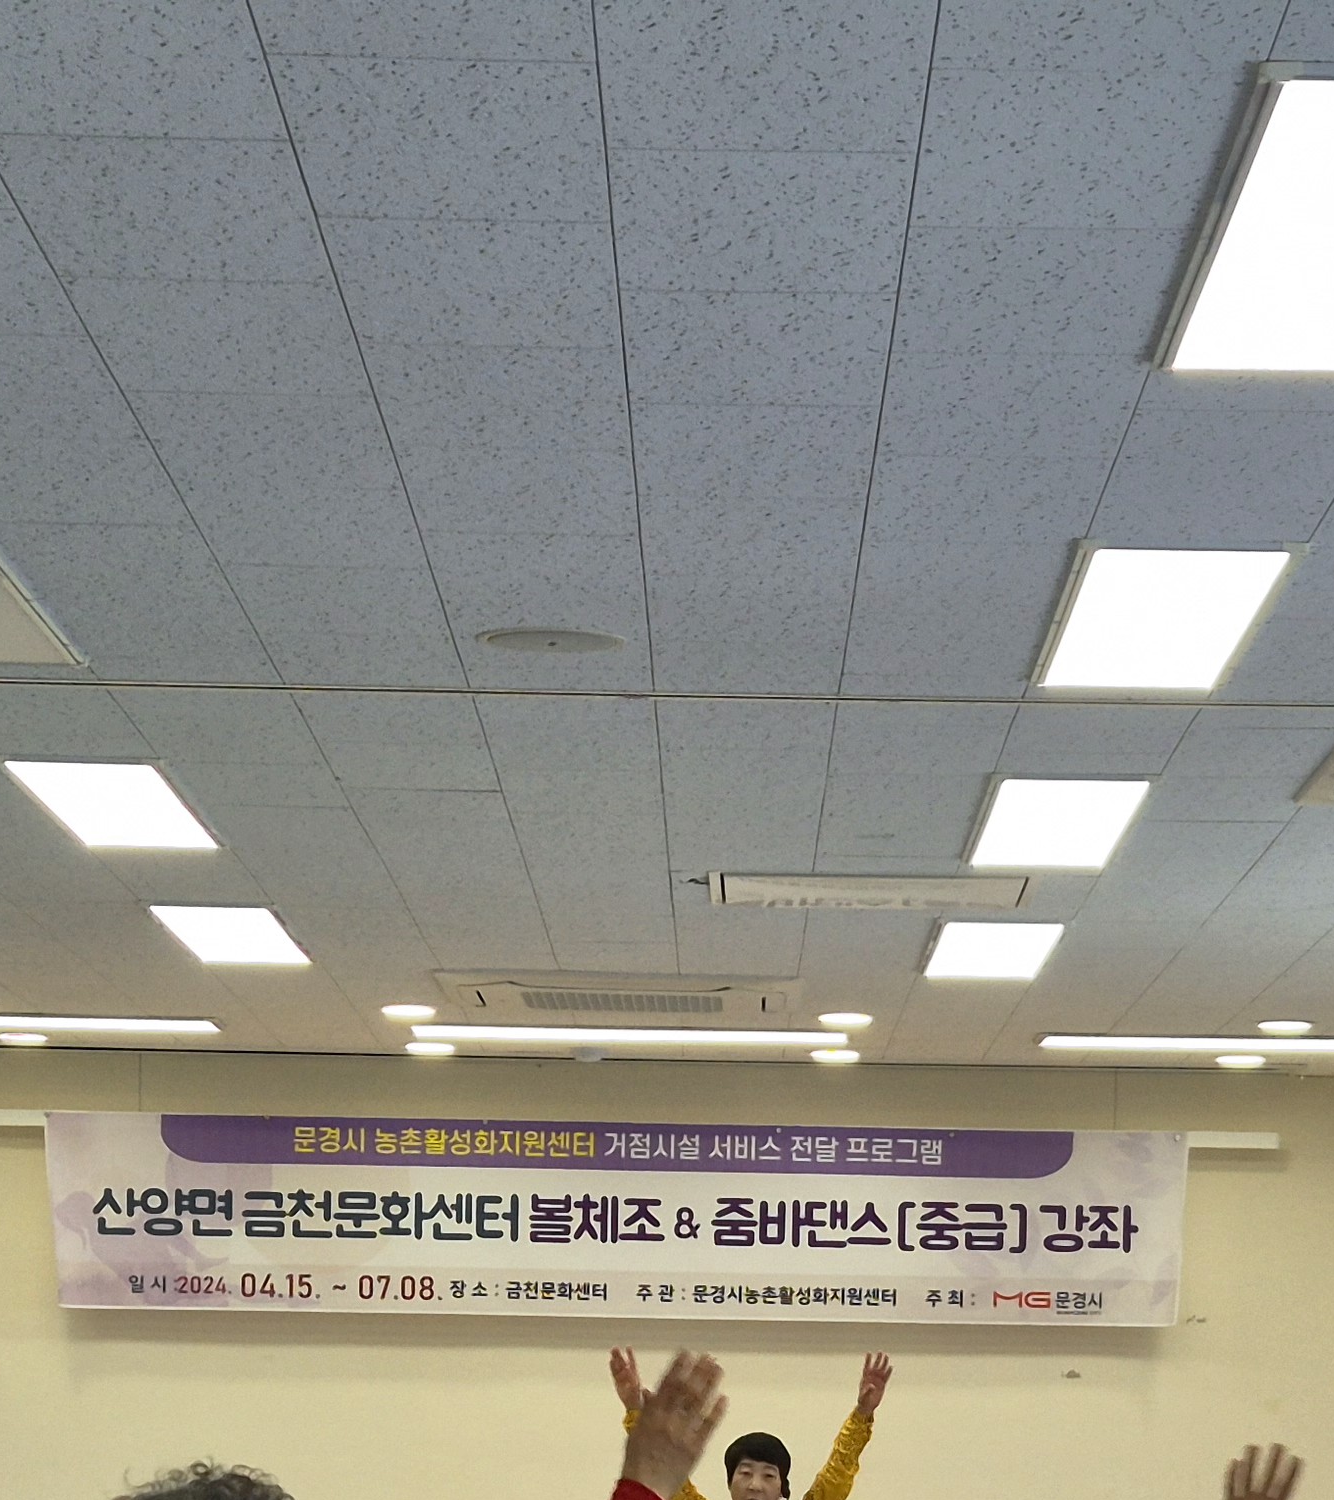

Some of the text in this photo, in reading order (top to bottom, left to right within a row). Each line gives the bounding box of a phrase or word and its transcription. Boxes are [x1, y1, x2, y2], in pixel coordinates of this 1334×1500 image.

[293, 1126, 943, 1166] 문경시 농촌활성화지원센터 거점시설 서비스 전달 프로그램
[92, 1187, 234, 1237] 산양면
[241, 1188, 520, 1243] 금천문화센터
[528, 1193, 666, 1244] 볼체조
[673, 1206, 701, 1240] &
[1038, 1204, 1140, 1254] 강좌
[240, 1272, 321, 1300] 04.15.
[358, 1274, 444, 1301] 07.08.
[504, 1280, 608, 1302] 금천문화센터
[691, 1284, 898, 1307] 문경시농촌활성화지원센터
[1054, 1290, 1103, 1310] 문경시
